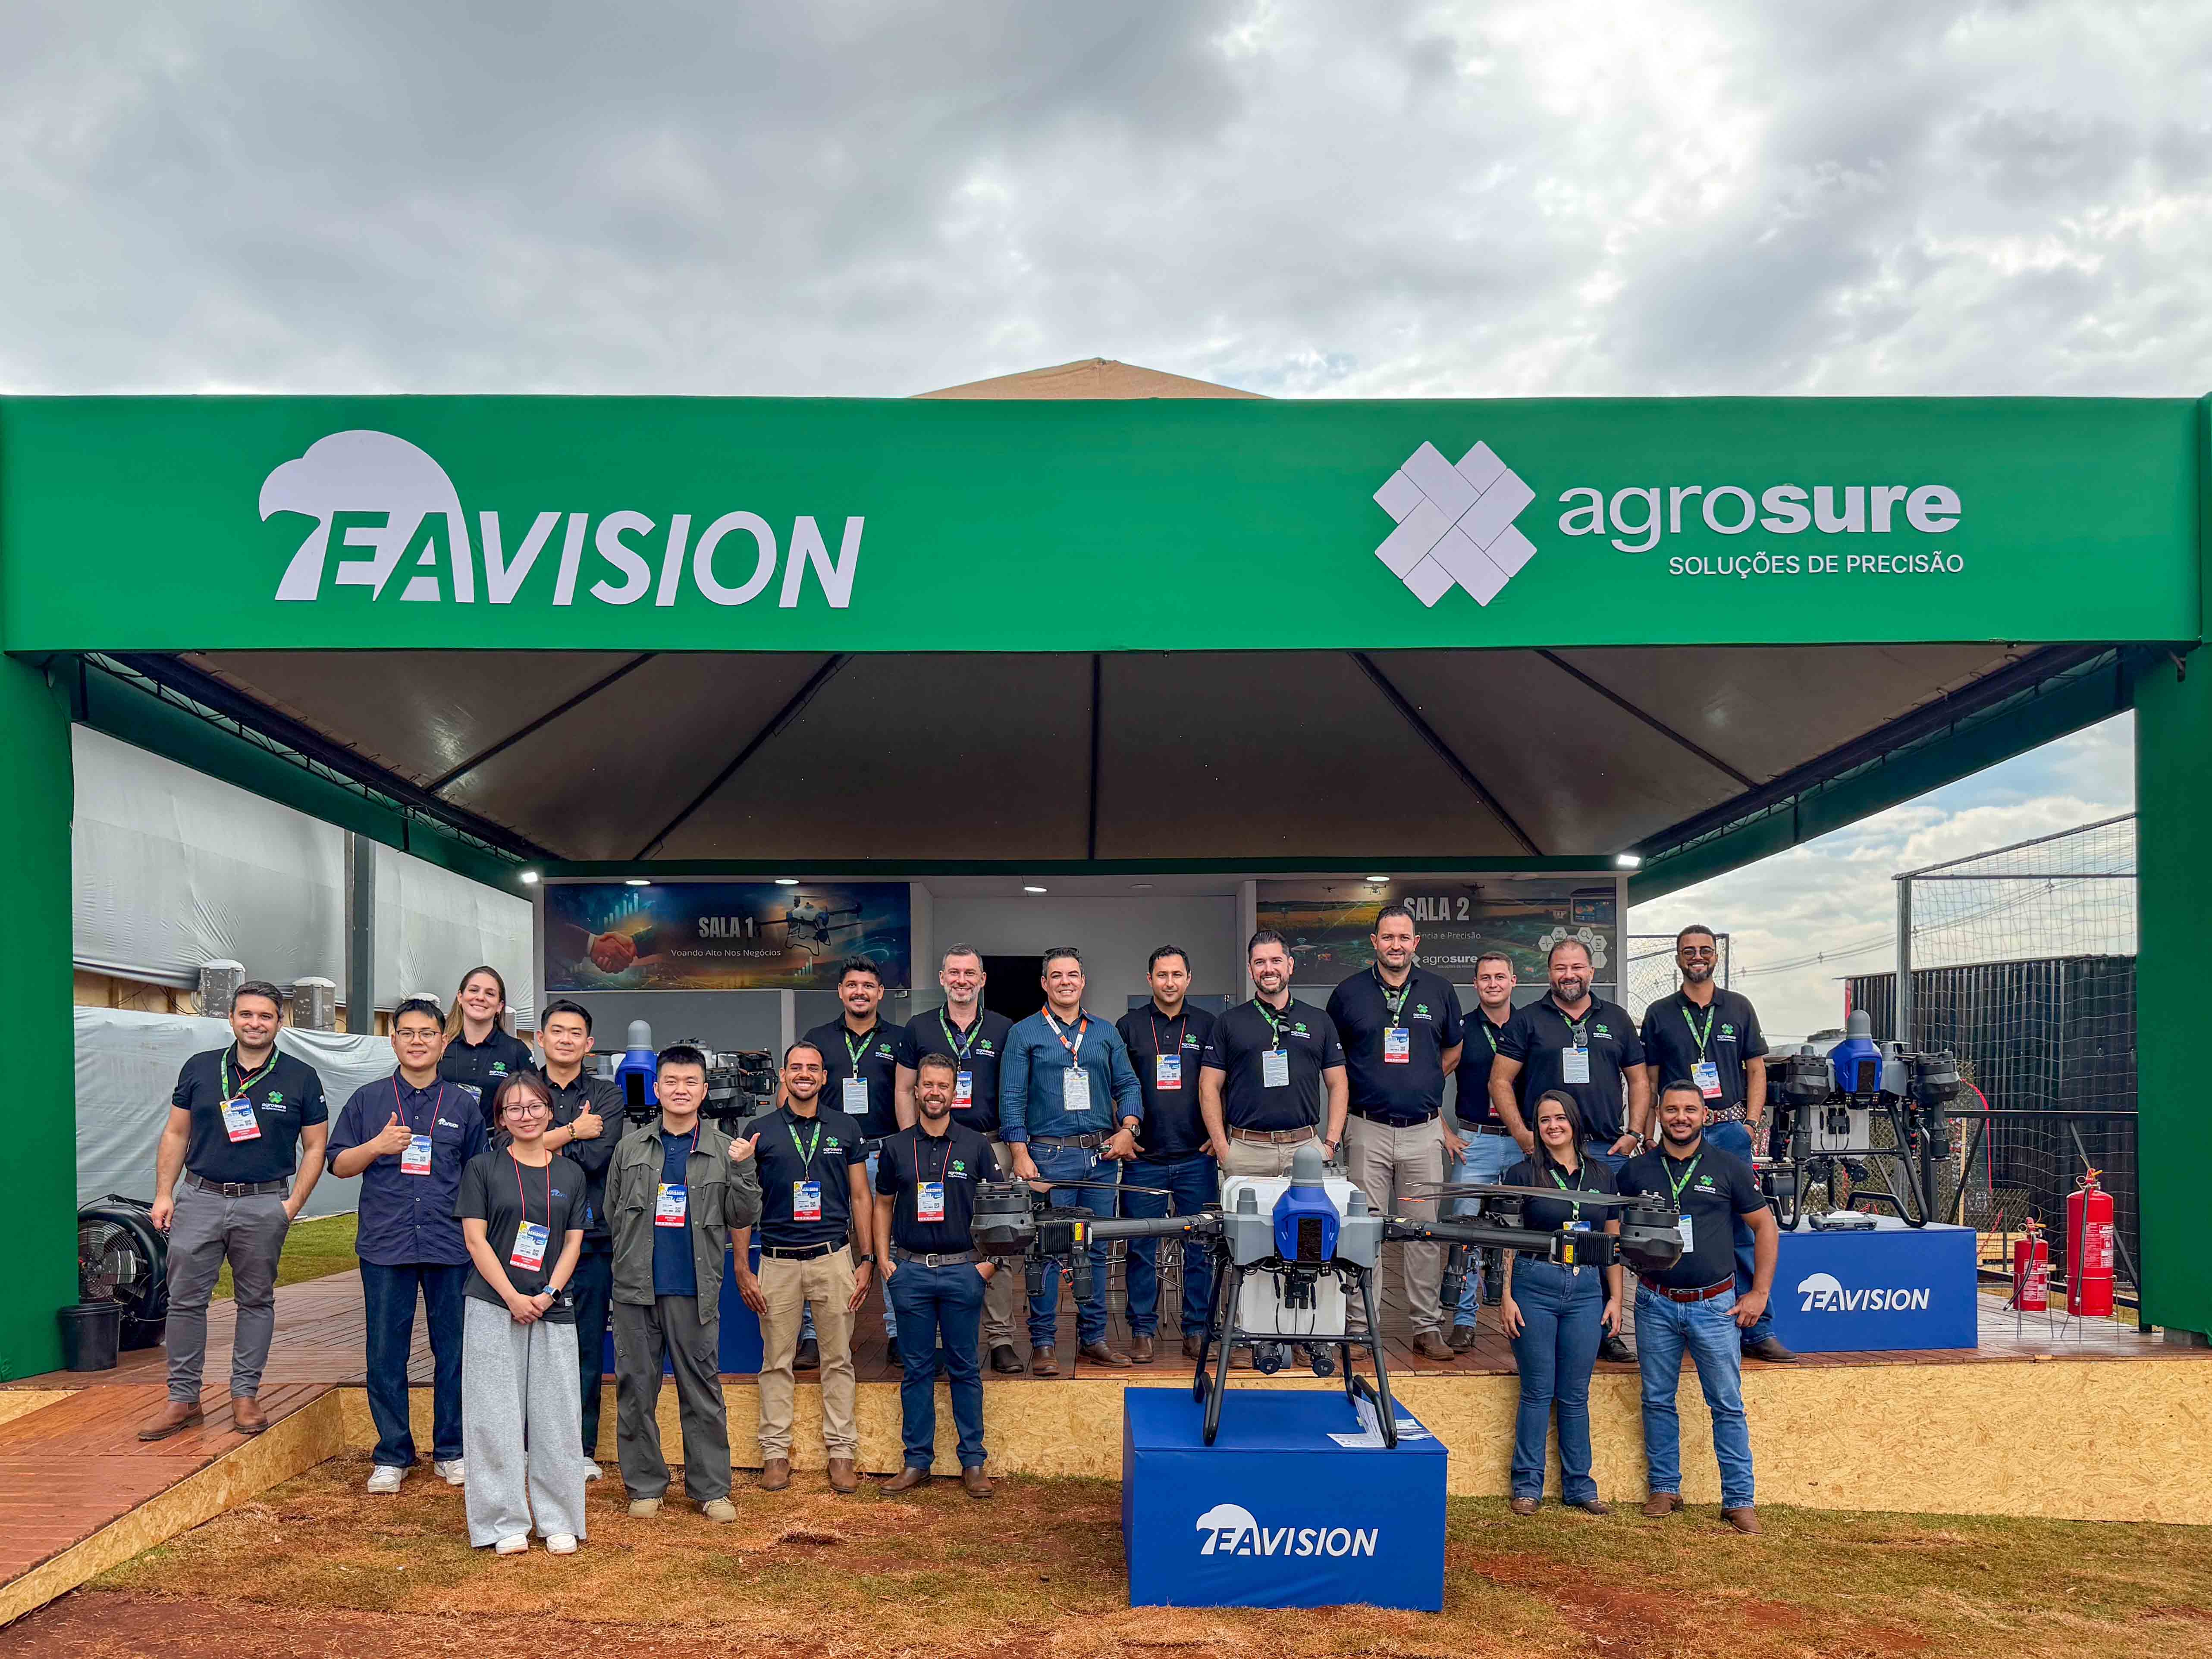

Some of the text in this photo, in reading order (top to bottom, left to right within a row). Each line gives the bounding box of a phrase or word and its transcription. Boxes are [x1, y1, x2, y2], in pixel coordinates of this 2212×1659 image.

[1557, 483, 1962, 553] agrosure
[1669, 551, 1964, 580] SOLUÇÕES DE PRECISÃO
[1403, 897, 1470, 921] SALA 2
[698, 917, 753, 938] SALA 1
[1447, 931, 1481, 940] Precisão
[743, 949, 781, 958] Negócios
[1422, 955, 1478, 966] agrosure
